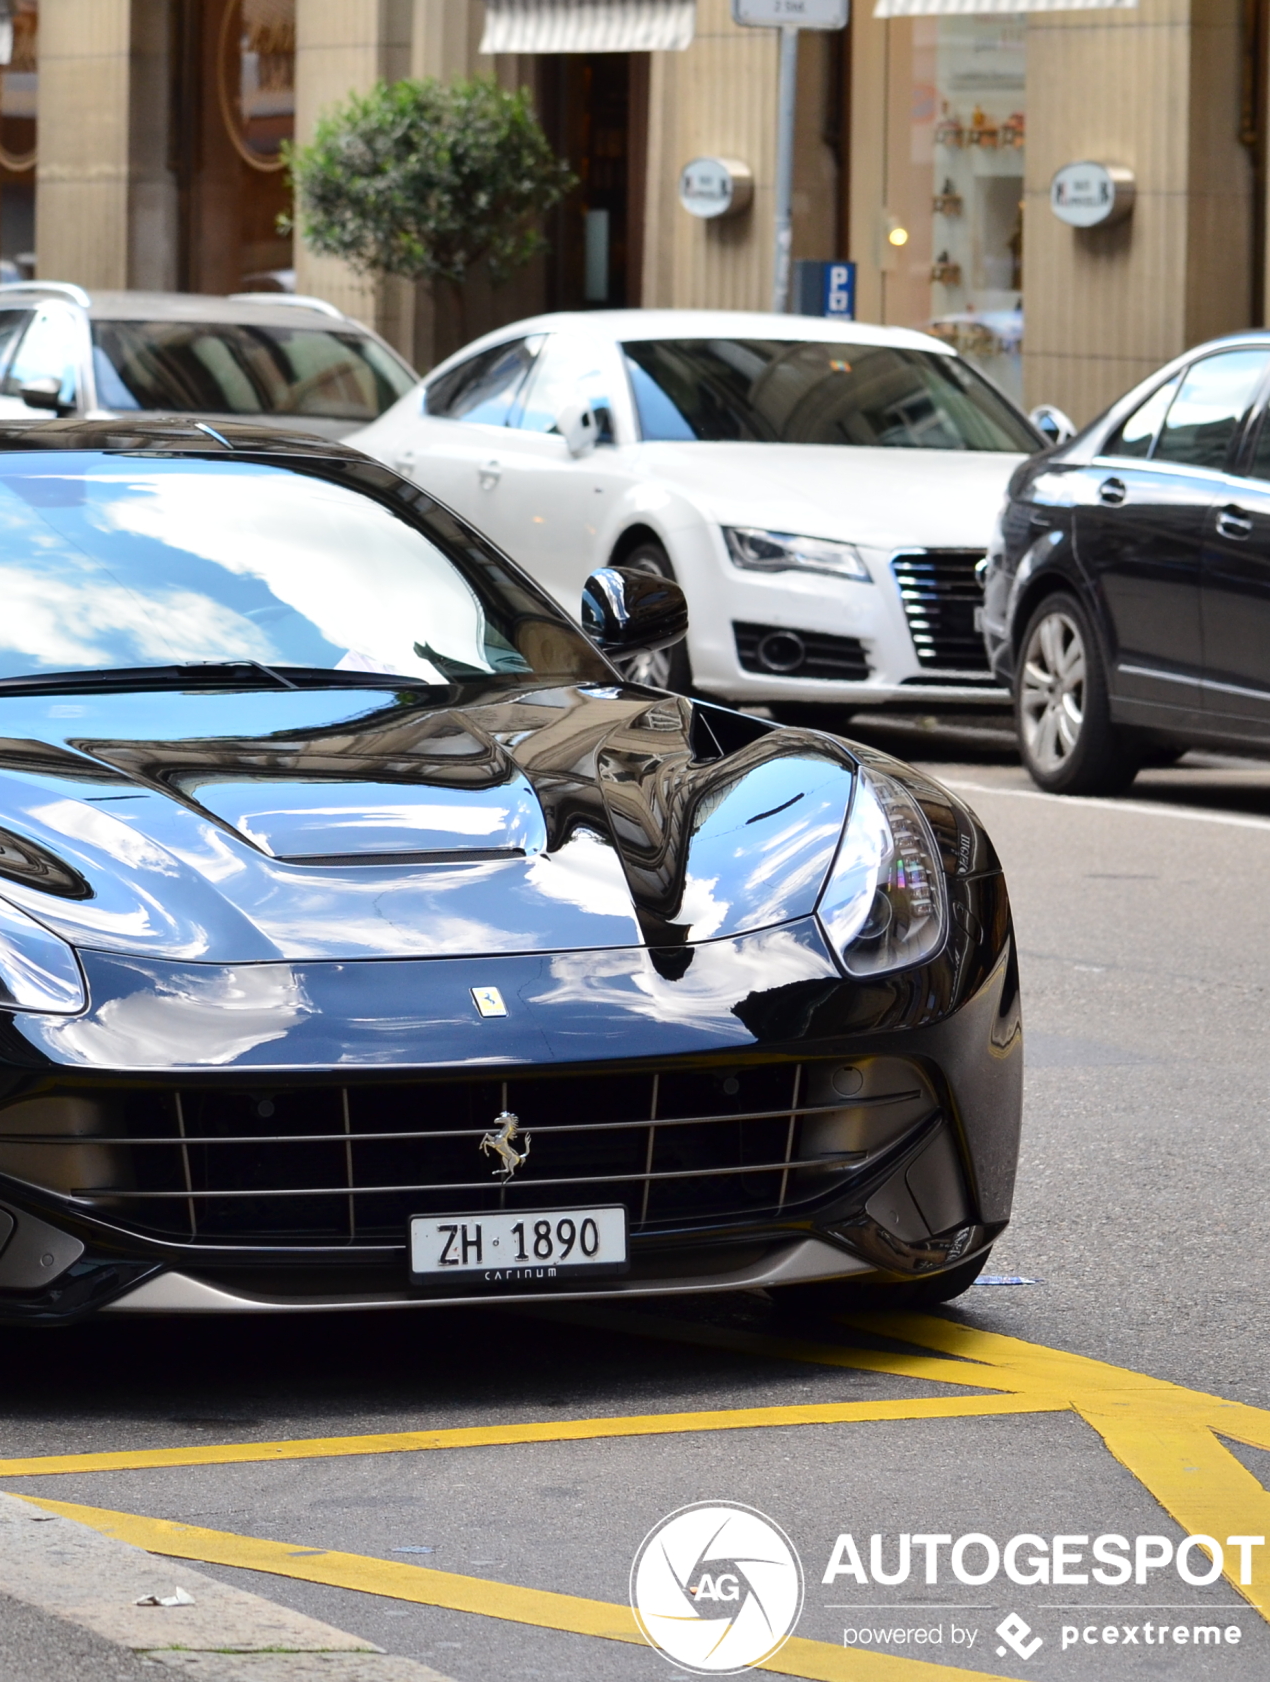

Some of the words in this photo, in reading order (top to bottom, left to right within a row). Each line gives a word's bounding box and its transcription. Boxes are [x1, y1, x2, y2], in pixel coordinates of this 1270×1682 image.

[830, 266, 848, 291] P
[437, 1222, 483, 1266] ZH
[510, 1217, 599, 1262] 1890
